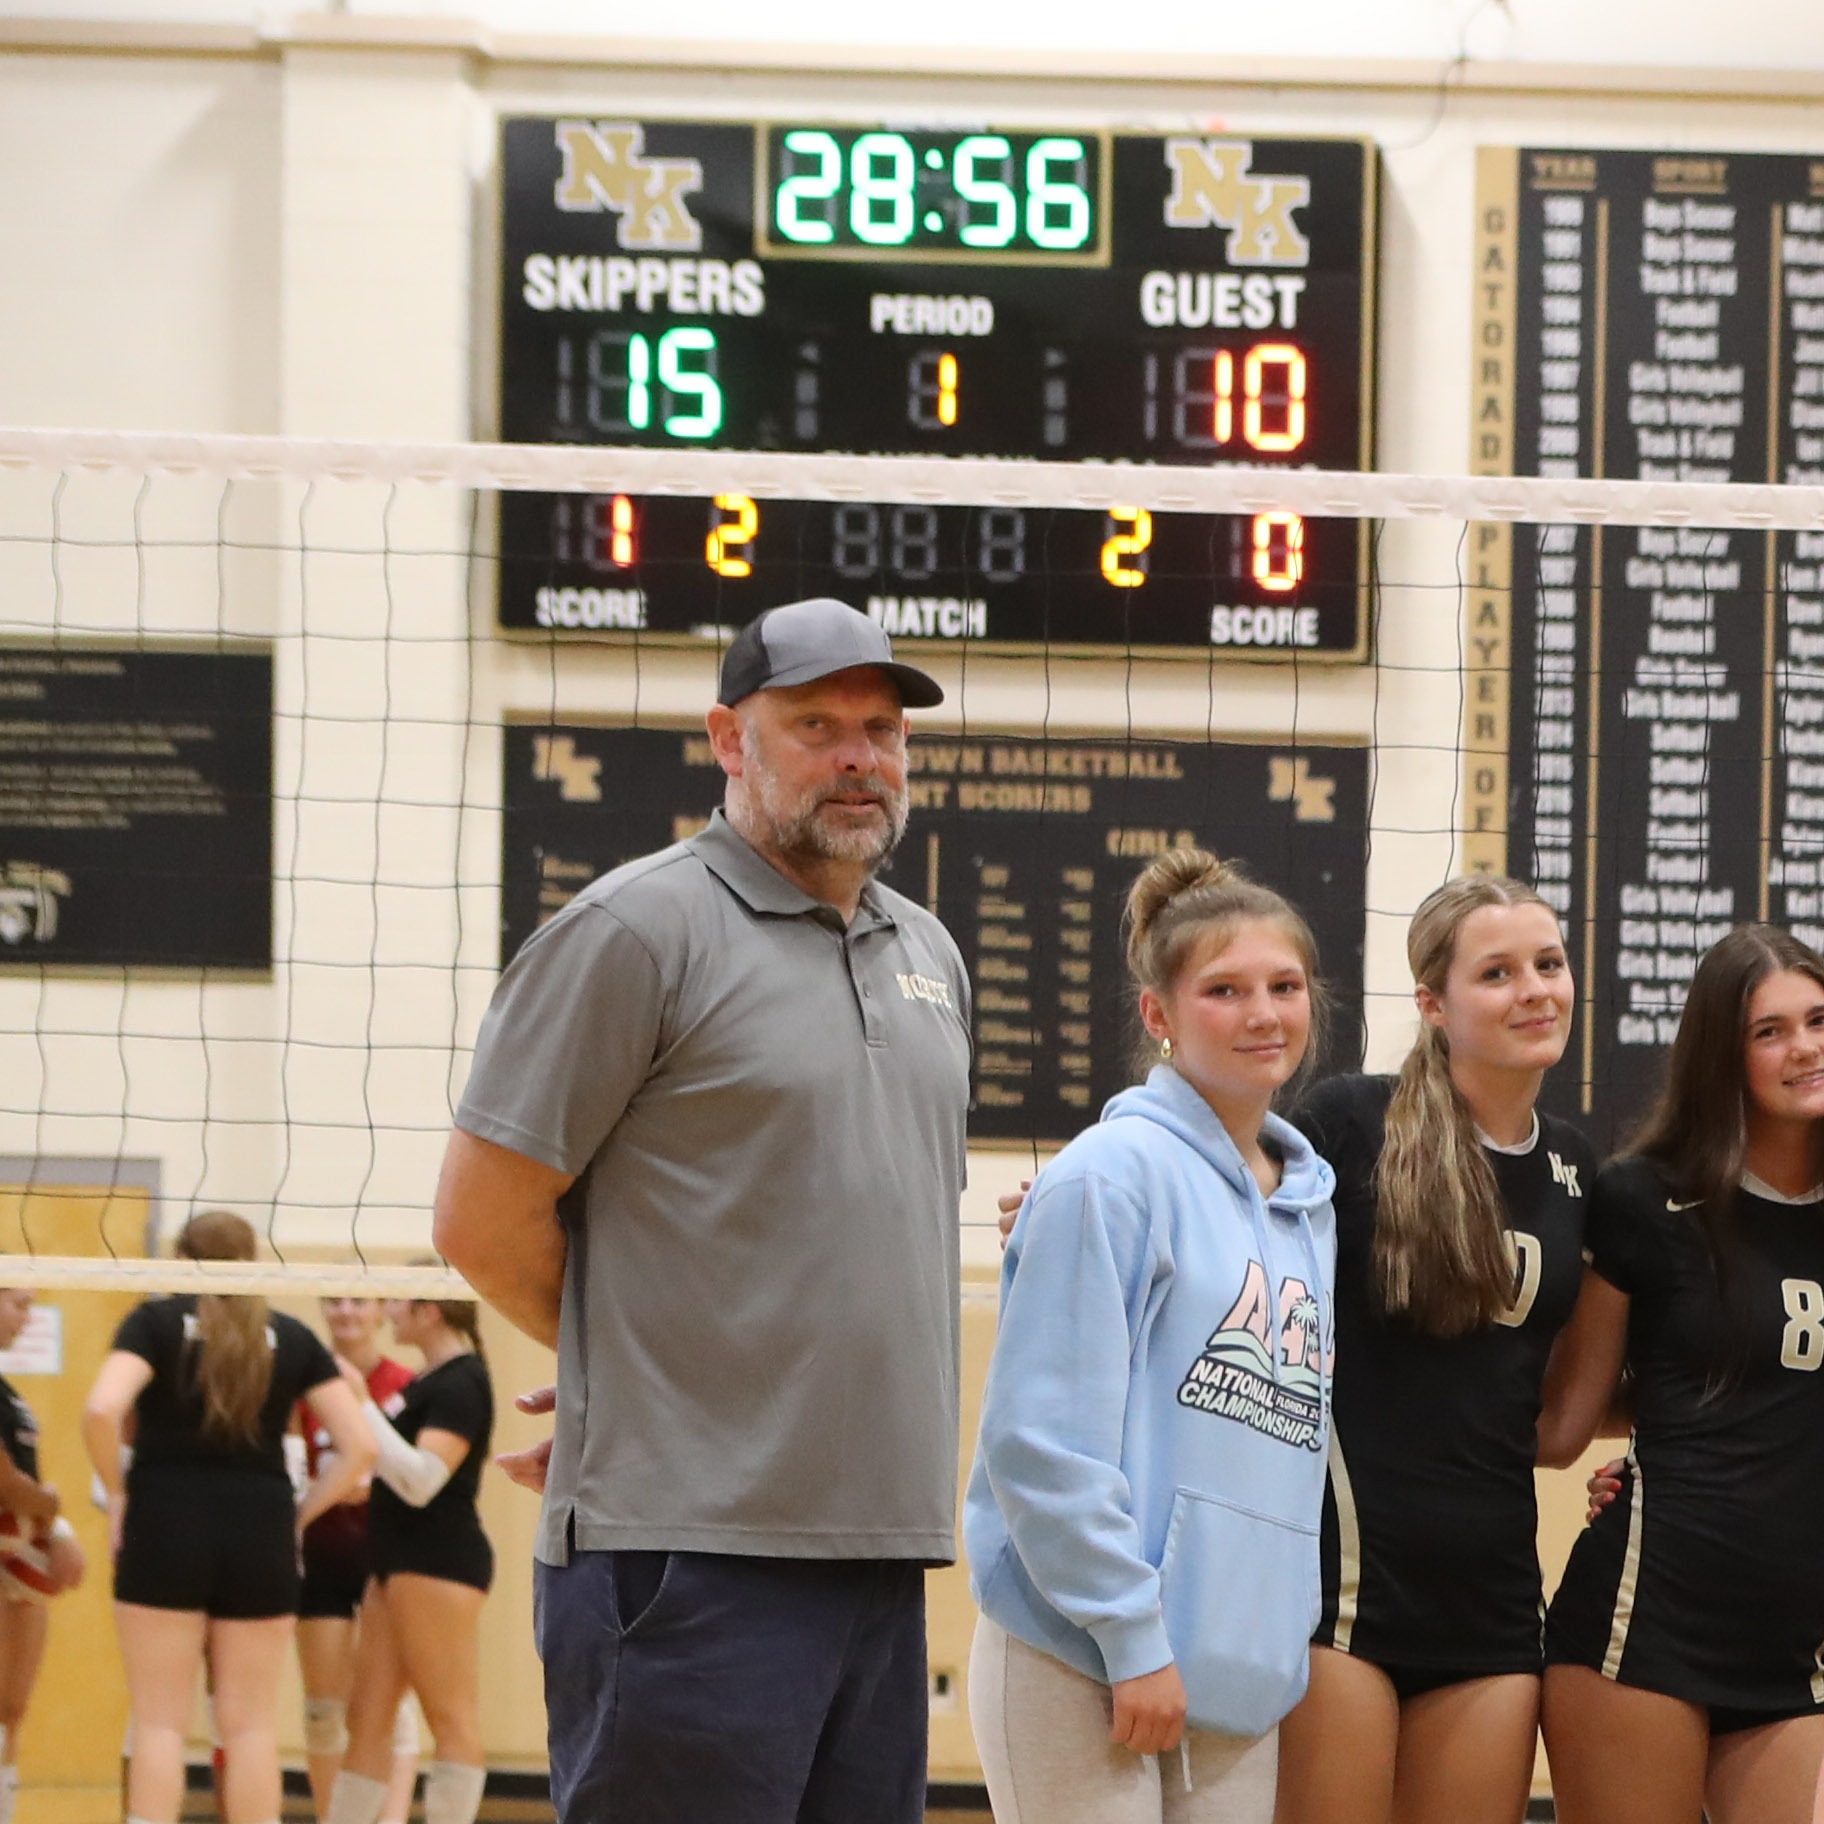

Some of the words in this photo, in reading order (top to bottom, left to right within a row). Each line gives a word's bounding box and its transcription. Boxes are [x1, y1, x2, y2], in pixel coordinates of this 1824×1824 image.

[776, 130, 1091, 250] 28:56
[522, 258, 765, 317] SKIPPERS
[872, 294, 993, 337] PERIOD
[1141, 273, 1307, 330] GUEST
[1479, 206, 1507, 478] GATORAD
[626, 326, 724, 440] 15
[1213, 344, 1308, 451] 10
[706, 492, 760, 577] 2
[1100, 505, 1152, 588] 2
[536, 587, 647, 630] SCORE
[868, 599, 987, 640] MATCH
[1210, 604, 1320, 647] SCORE
[990, 748, 1184, 779] BASKETBALL
[957, 782, 1091, 813] SCORERS
[1107, 828, 1195, 858] GIRLS
[1190, 1359, 1276, 1407] NATIONAL
[1276, 1395, 1308, 1416] FLORIDA
